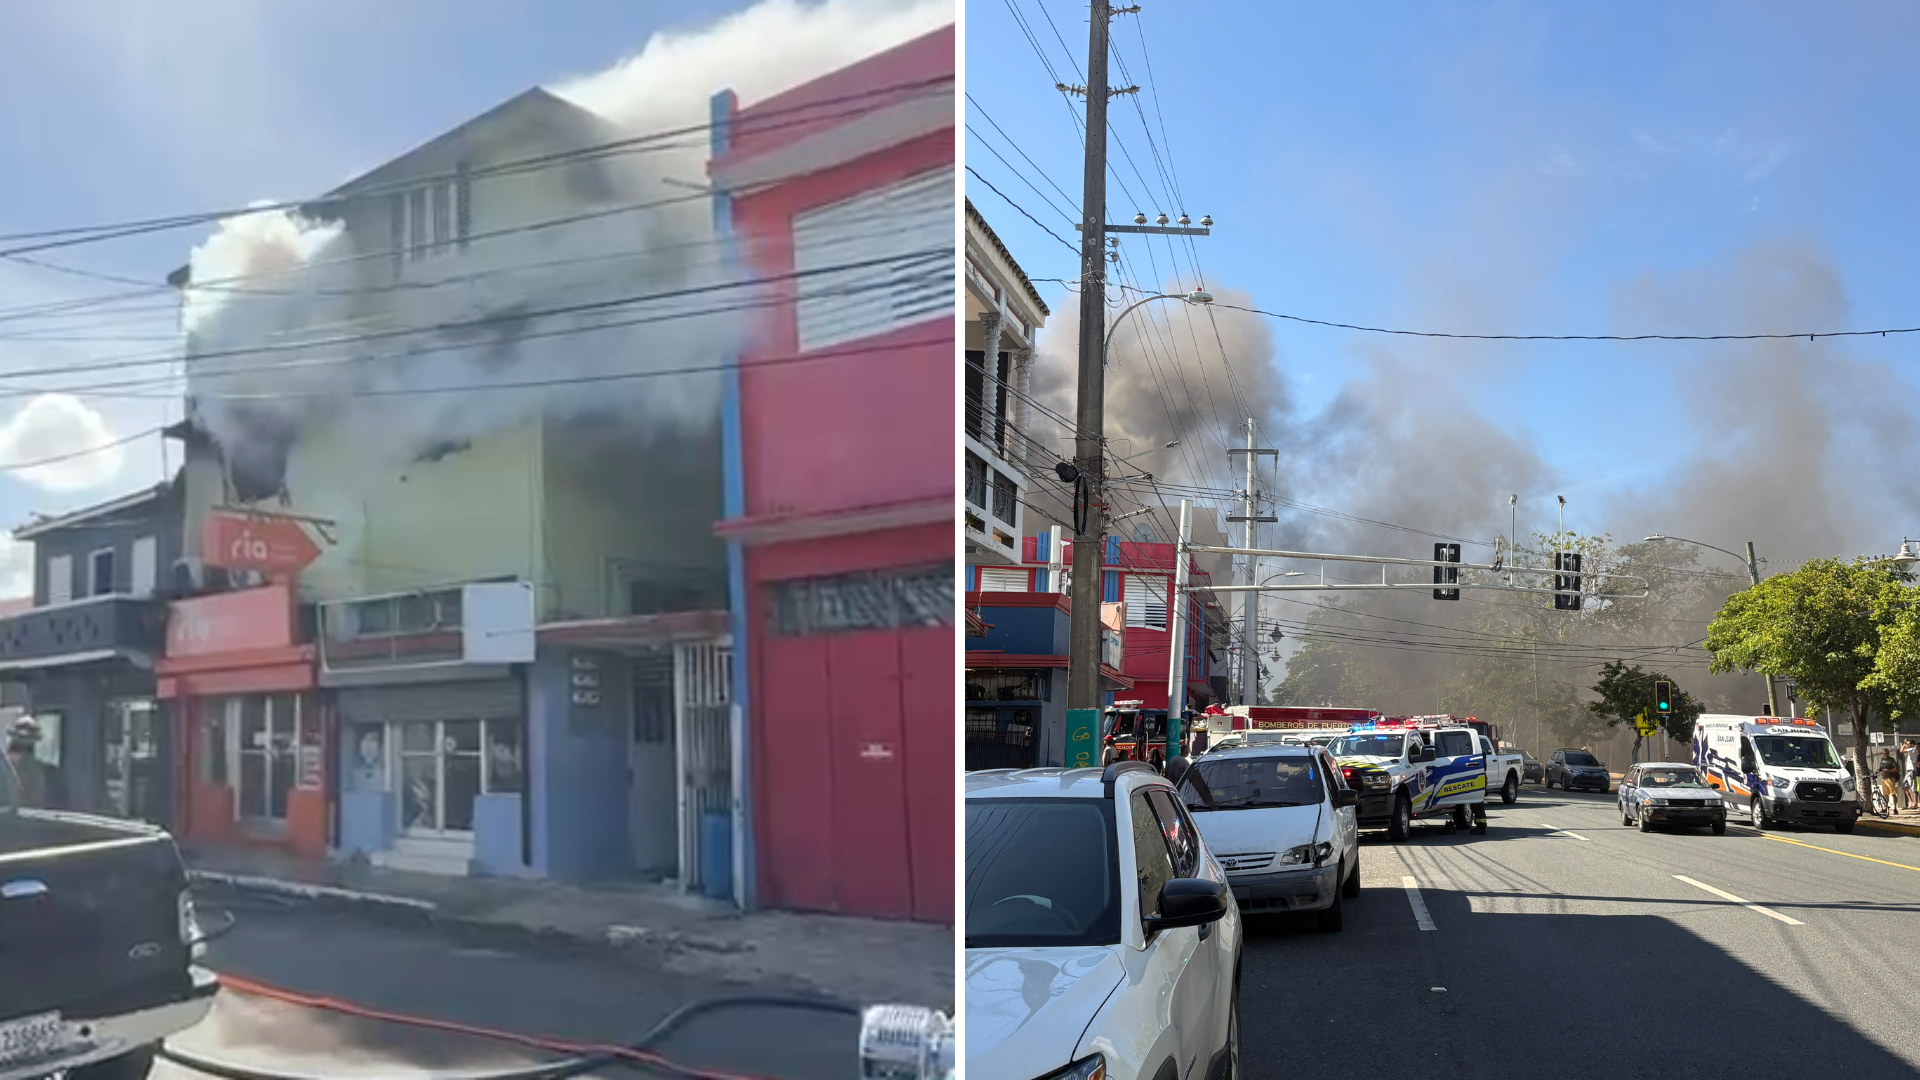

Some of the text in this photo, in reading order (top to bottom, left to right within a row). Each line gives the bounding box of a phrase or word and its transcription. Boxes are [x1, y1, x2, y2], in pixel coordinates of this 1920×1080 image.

[231, 529, 268, 560] ria
[1258, 721, 1304, 729] BOMBEROS
[1443, 782, 1475, 792] RESCATE
